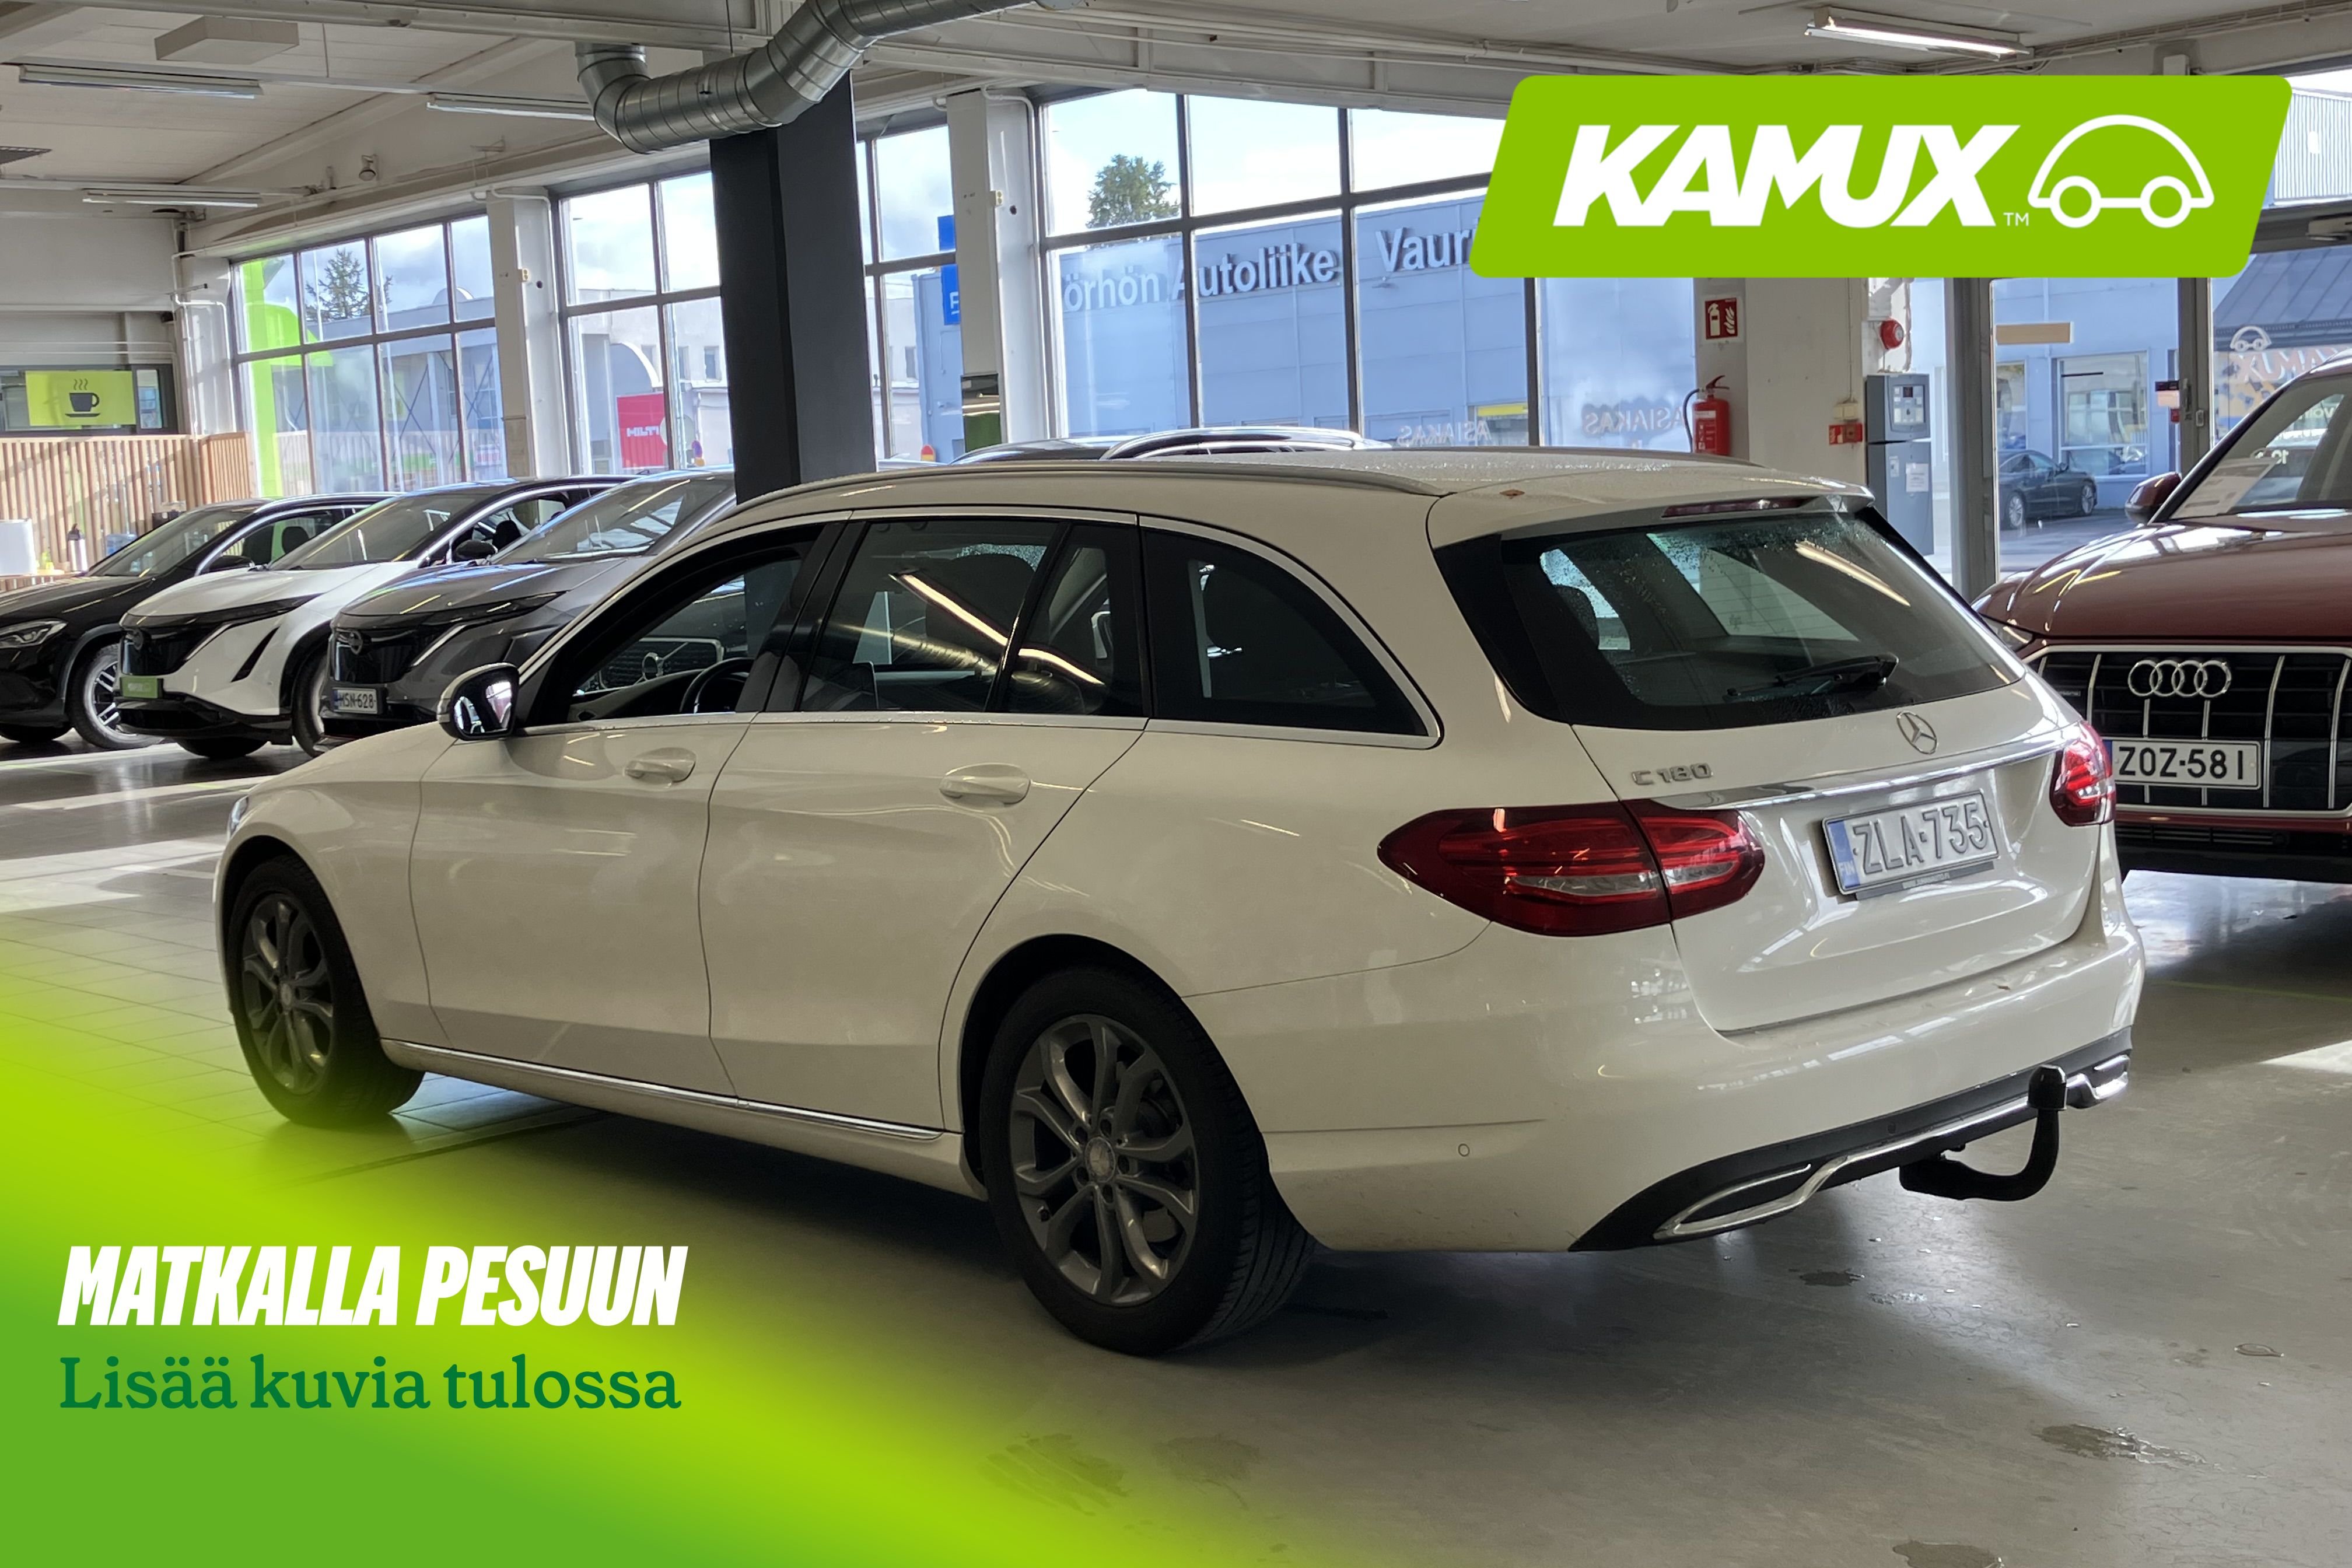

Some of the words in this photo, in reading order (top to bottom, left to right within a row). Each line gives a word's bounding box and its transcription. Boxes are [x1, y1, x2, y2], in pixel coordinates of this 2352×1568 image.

[1063, 265, 1160, 312] örhön
[1632, 770, 1654, 785] C
[1656, 763, 1714, 783] 180
[1852, 799, 1988, 874] ZLA-735
